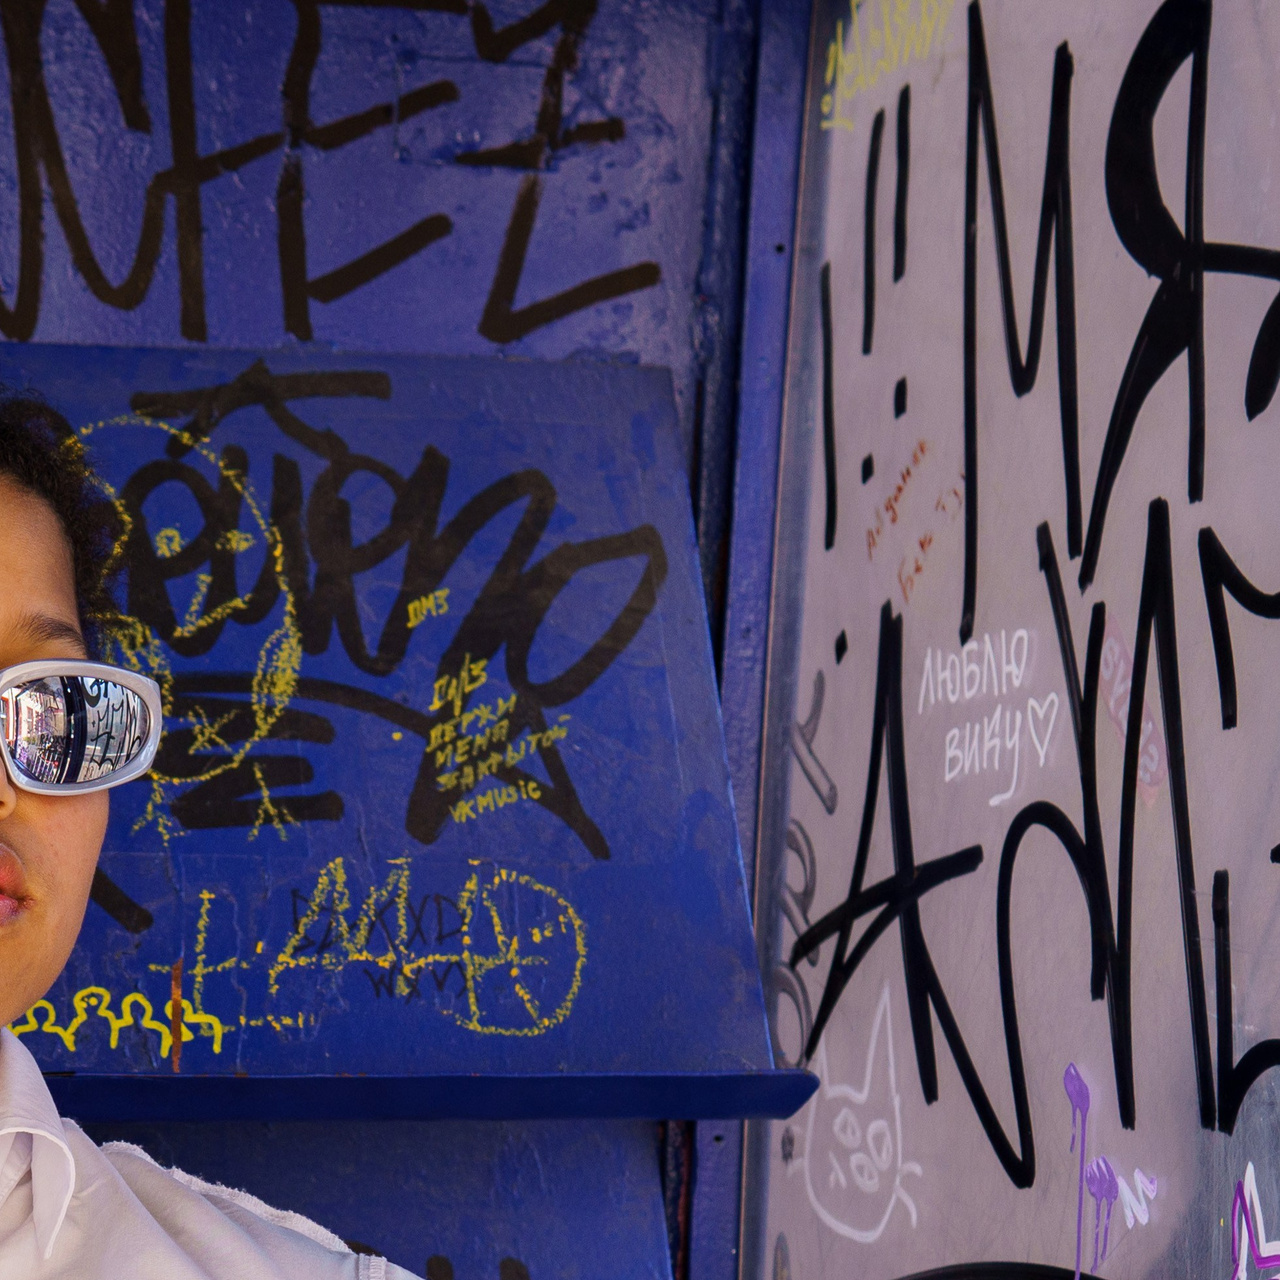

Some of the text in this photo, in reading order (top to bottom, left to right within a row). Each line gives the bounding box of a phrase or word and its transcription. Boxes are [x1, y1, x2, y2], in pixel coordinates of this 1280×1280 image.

[918, 628, 1029, 715] ЛЮБЛЮ
[425, 693, 518, 753] ДЕРЖИ
[435, 719, 510, 769] МЕНЯ
